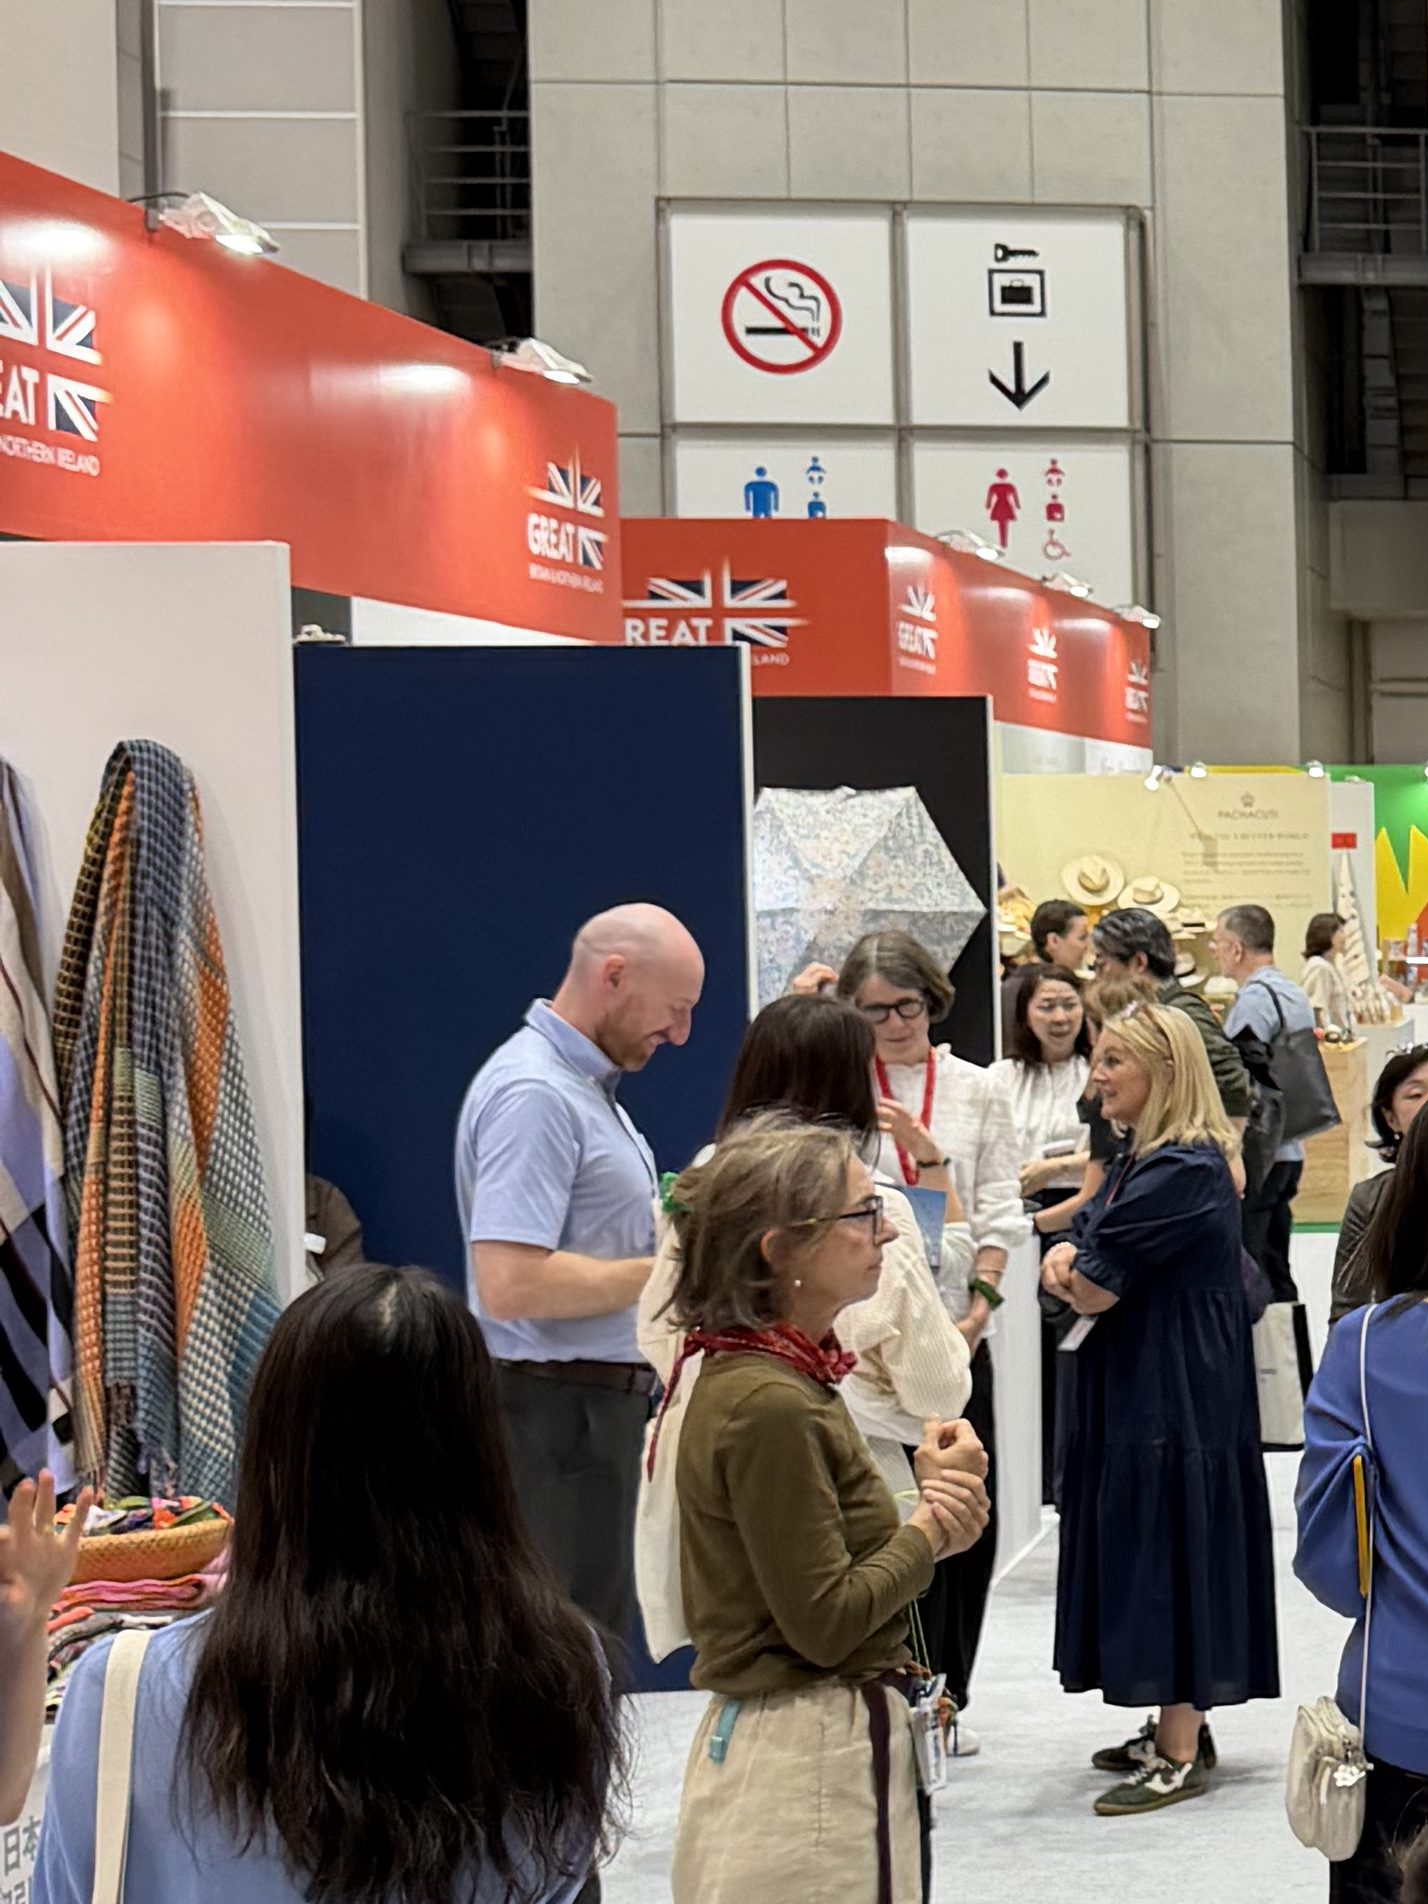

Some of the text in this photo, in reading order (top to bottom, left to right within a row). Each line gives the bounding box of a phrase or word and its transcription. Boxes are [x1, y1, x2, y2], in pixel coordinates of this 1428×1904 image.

[0, 359, 40, 426] AT
[527, 512, 575, 563] GREAT
[624, 618, 713, 645] REAT
